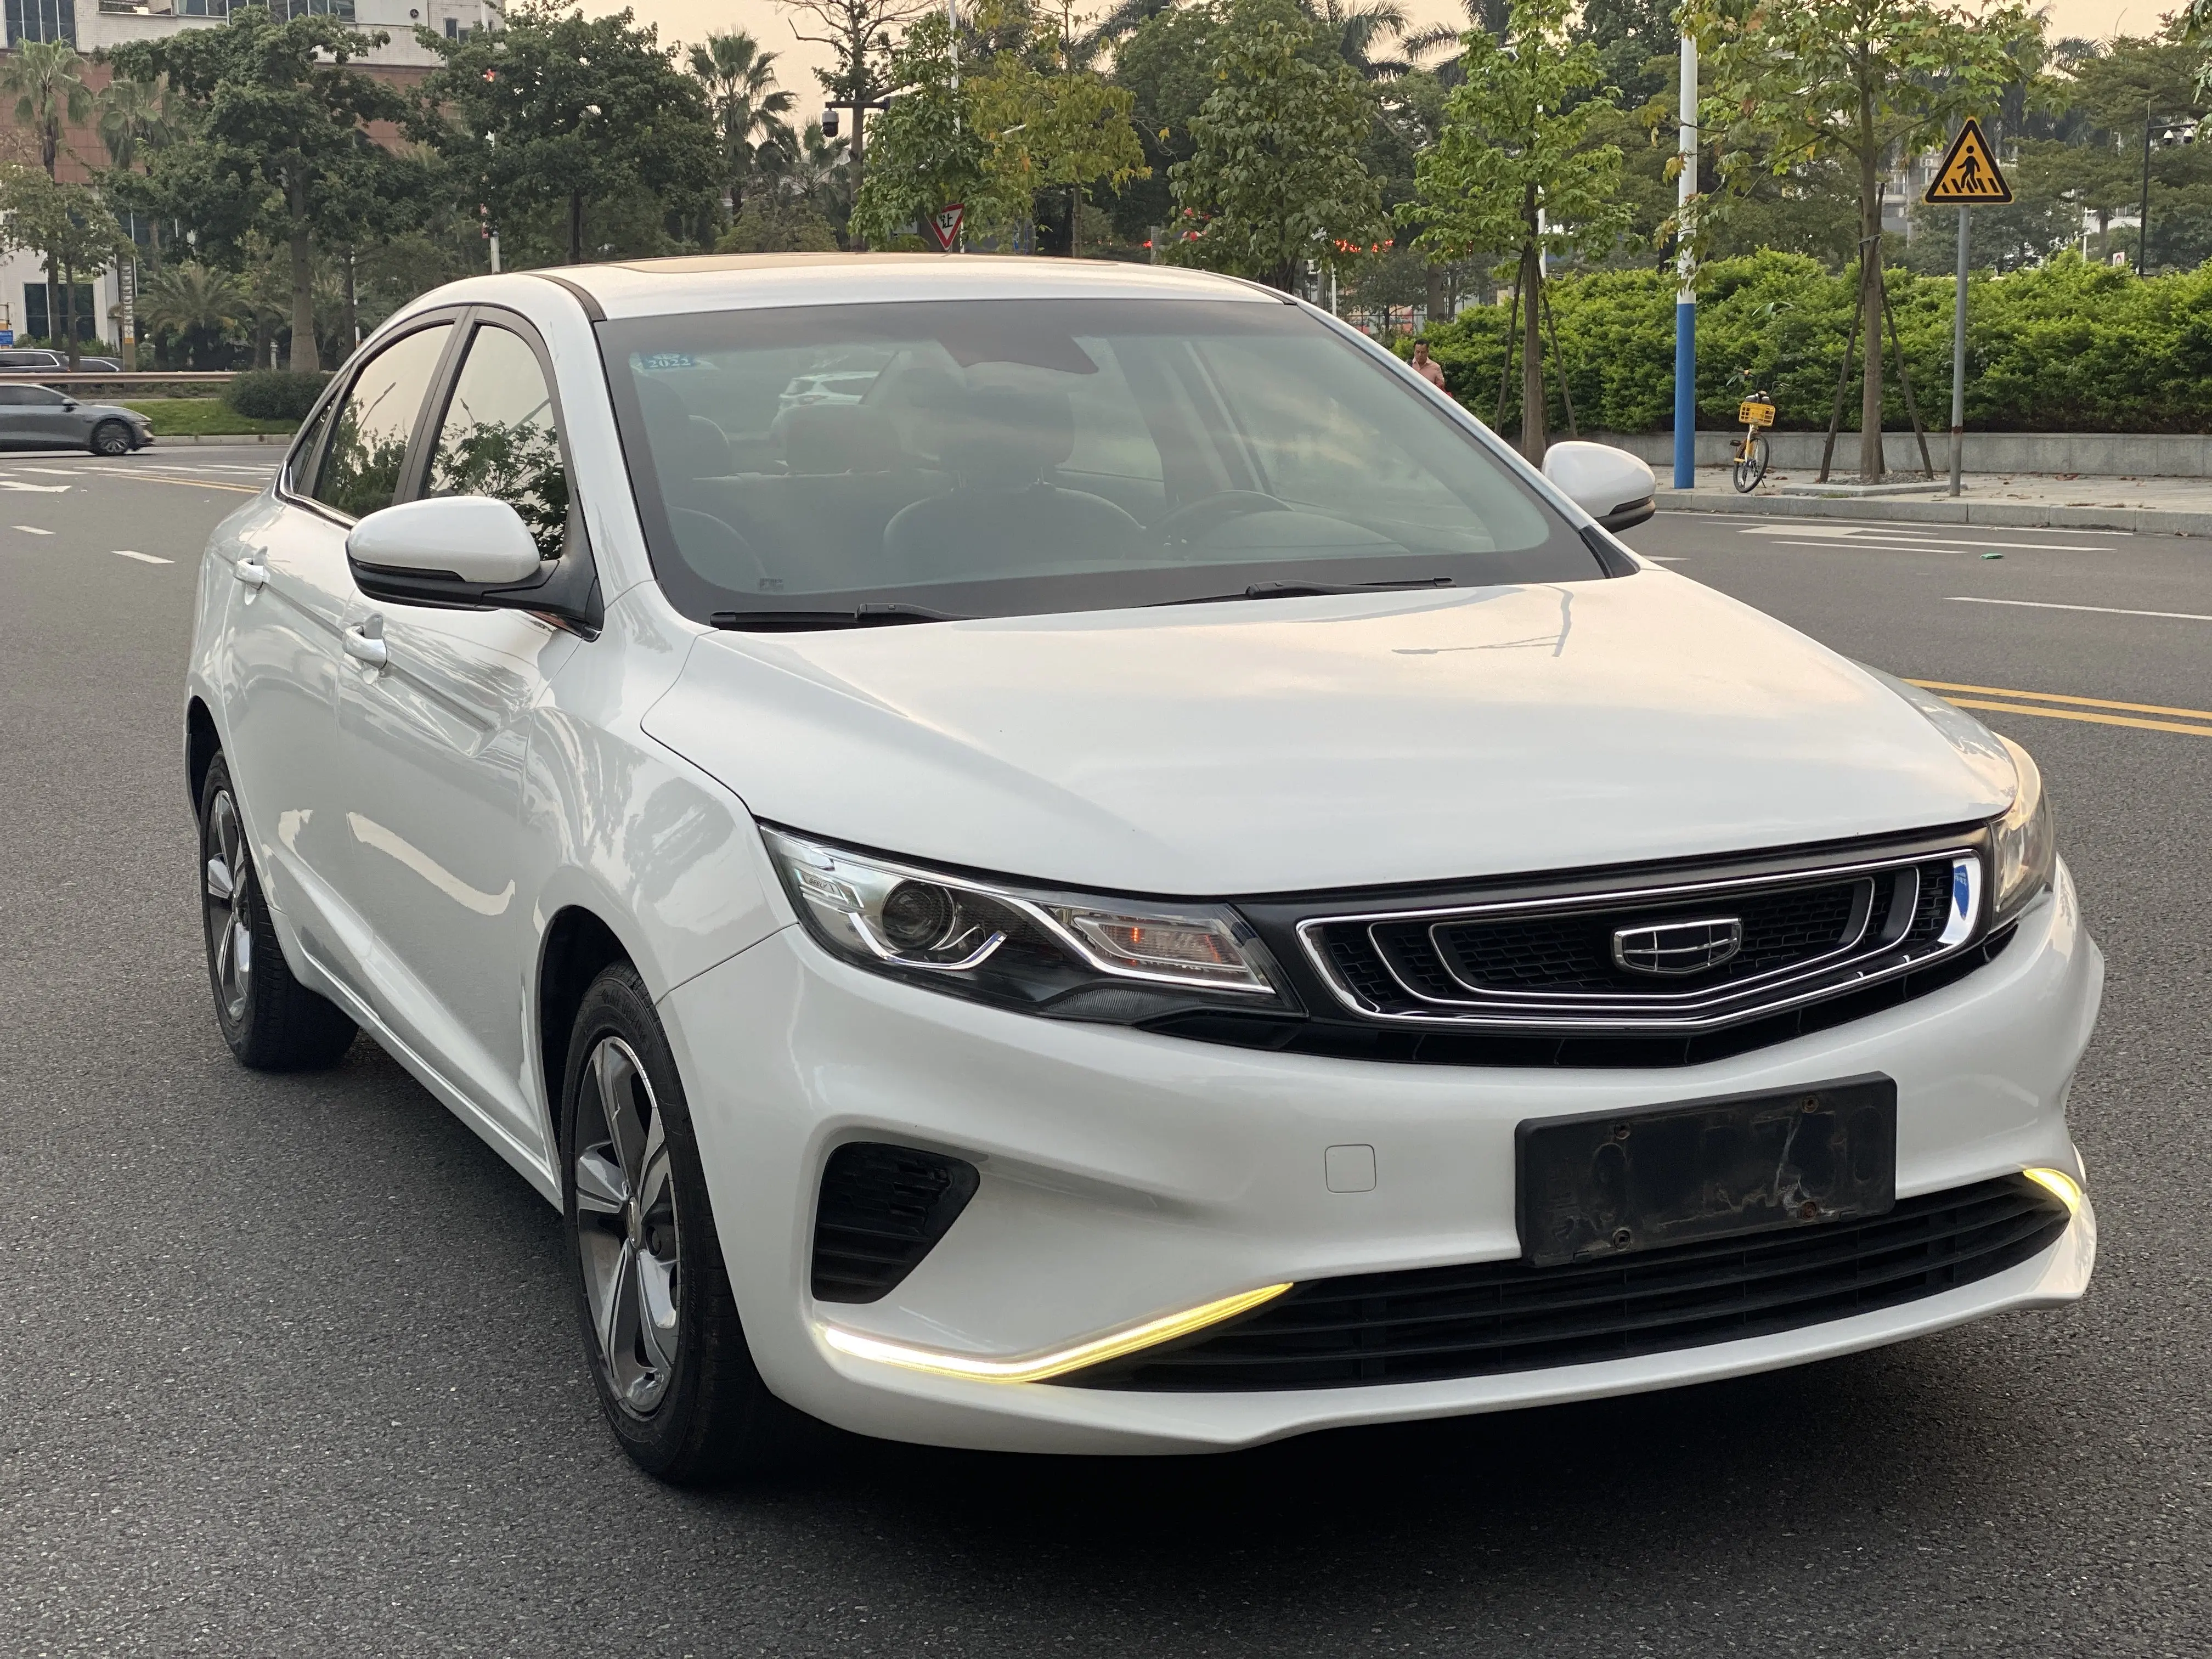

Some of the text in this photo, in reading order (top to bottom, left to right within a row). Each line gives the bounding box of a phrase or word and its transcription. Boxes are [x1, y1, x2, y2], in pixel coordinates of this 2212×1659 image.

[940, 213, 953, 229] 让
[648, 358, 691, 368] 2022
[809, 878, 827, 888] GEELY
